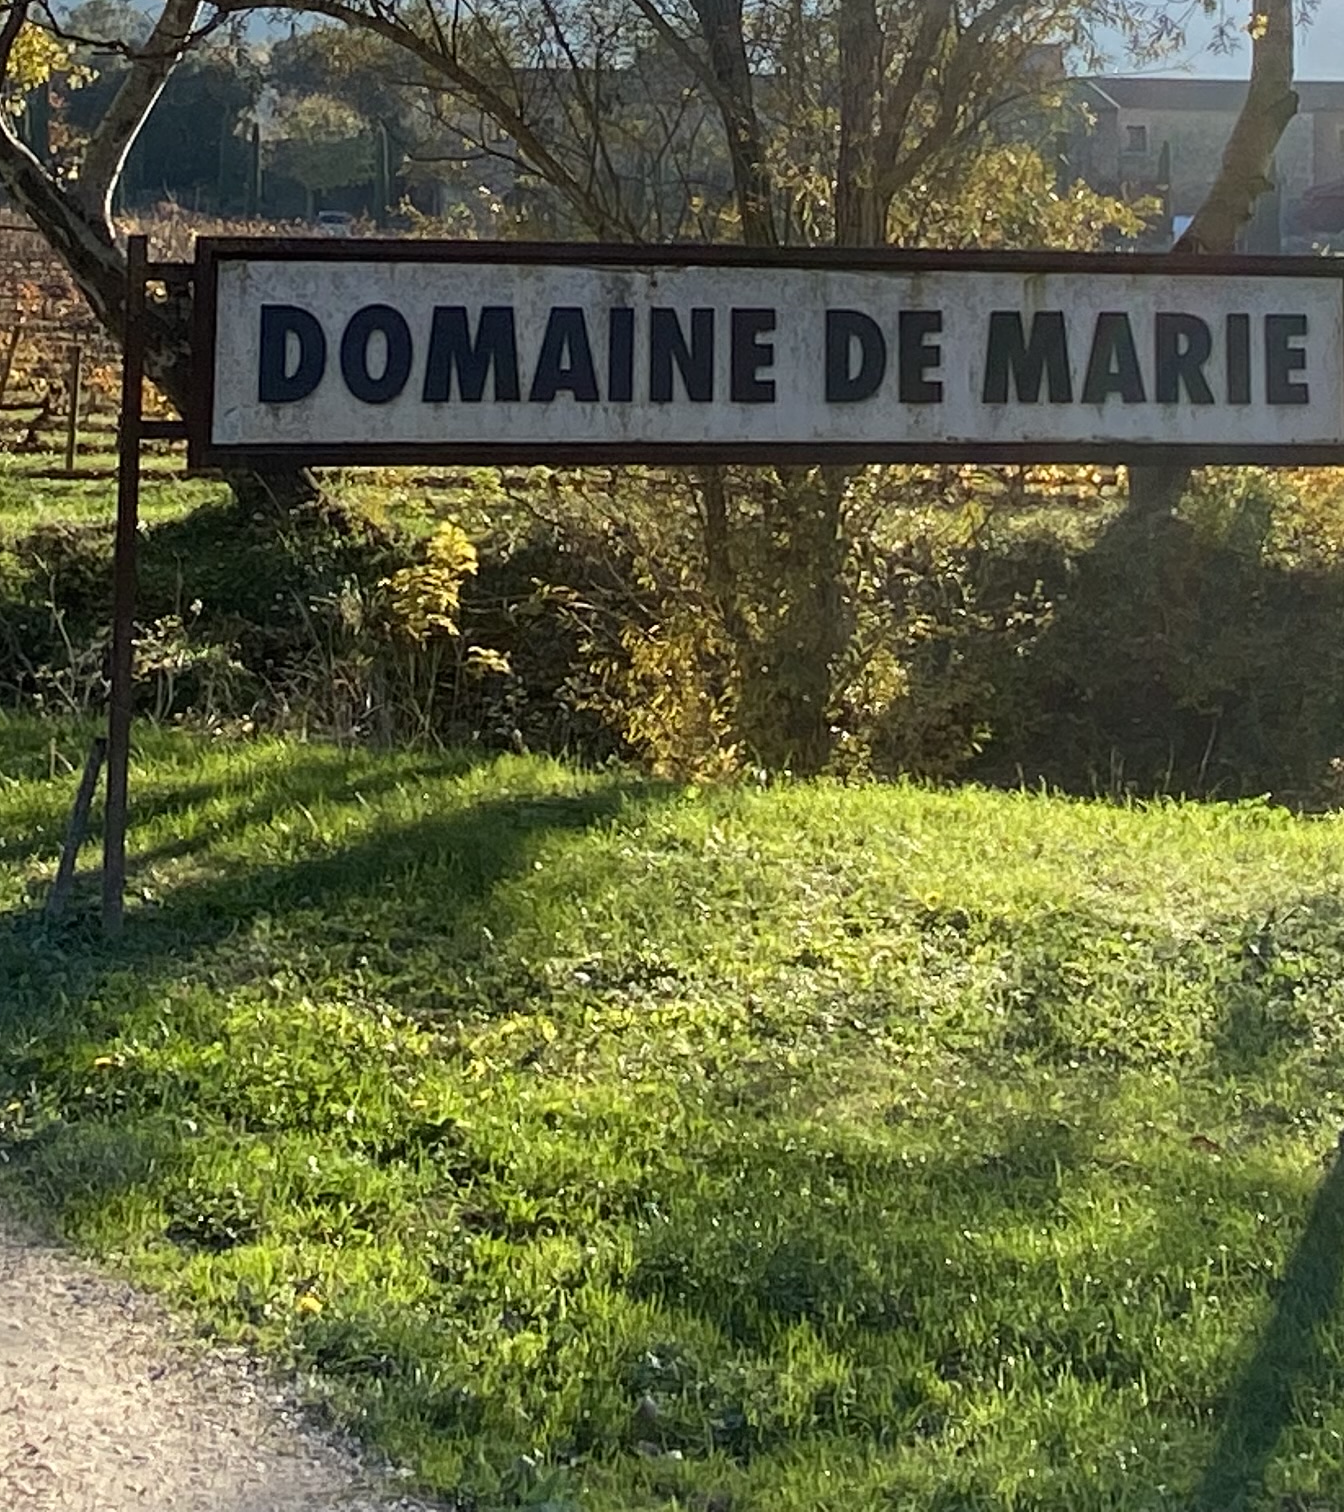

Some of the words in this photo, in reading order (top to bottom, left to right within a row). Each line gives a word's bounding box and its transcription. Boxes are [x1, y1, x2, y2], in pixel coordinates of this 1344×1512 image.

[258, 304, 777, 405] DOMAINE
[824, 310, 943, 405] DE
[982, 310, 1310, 406] MARIE
